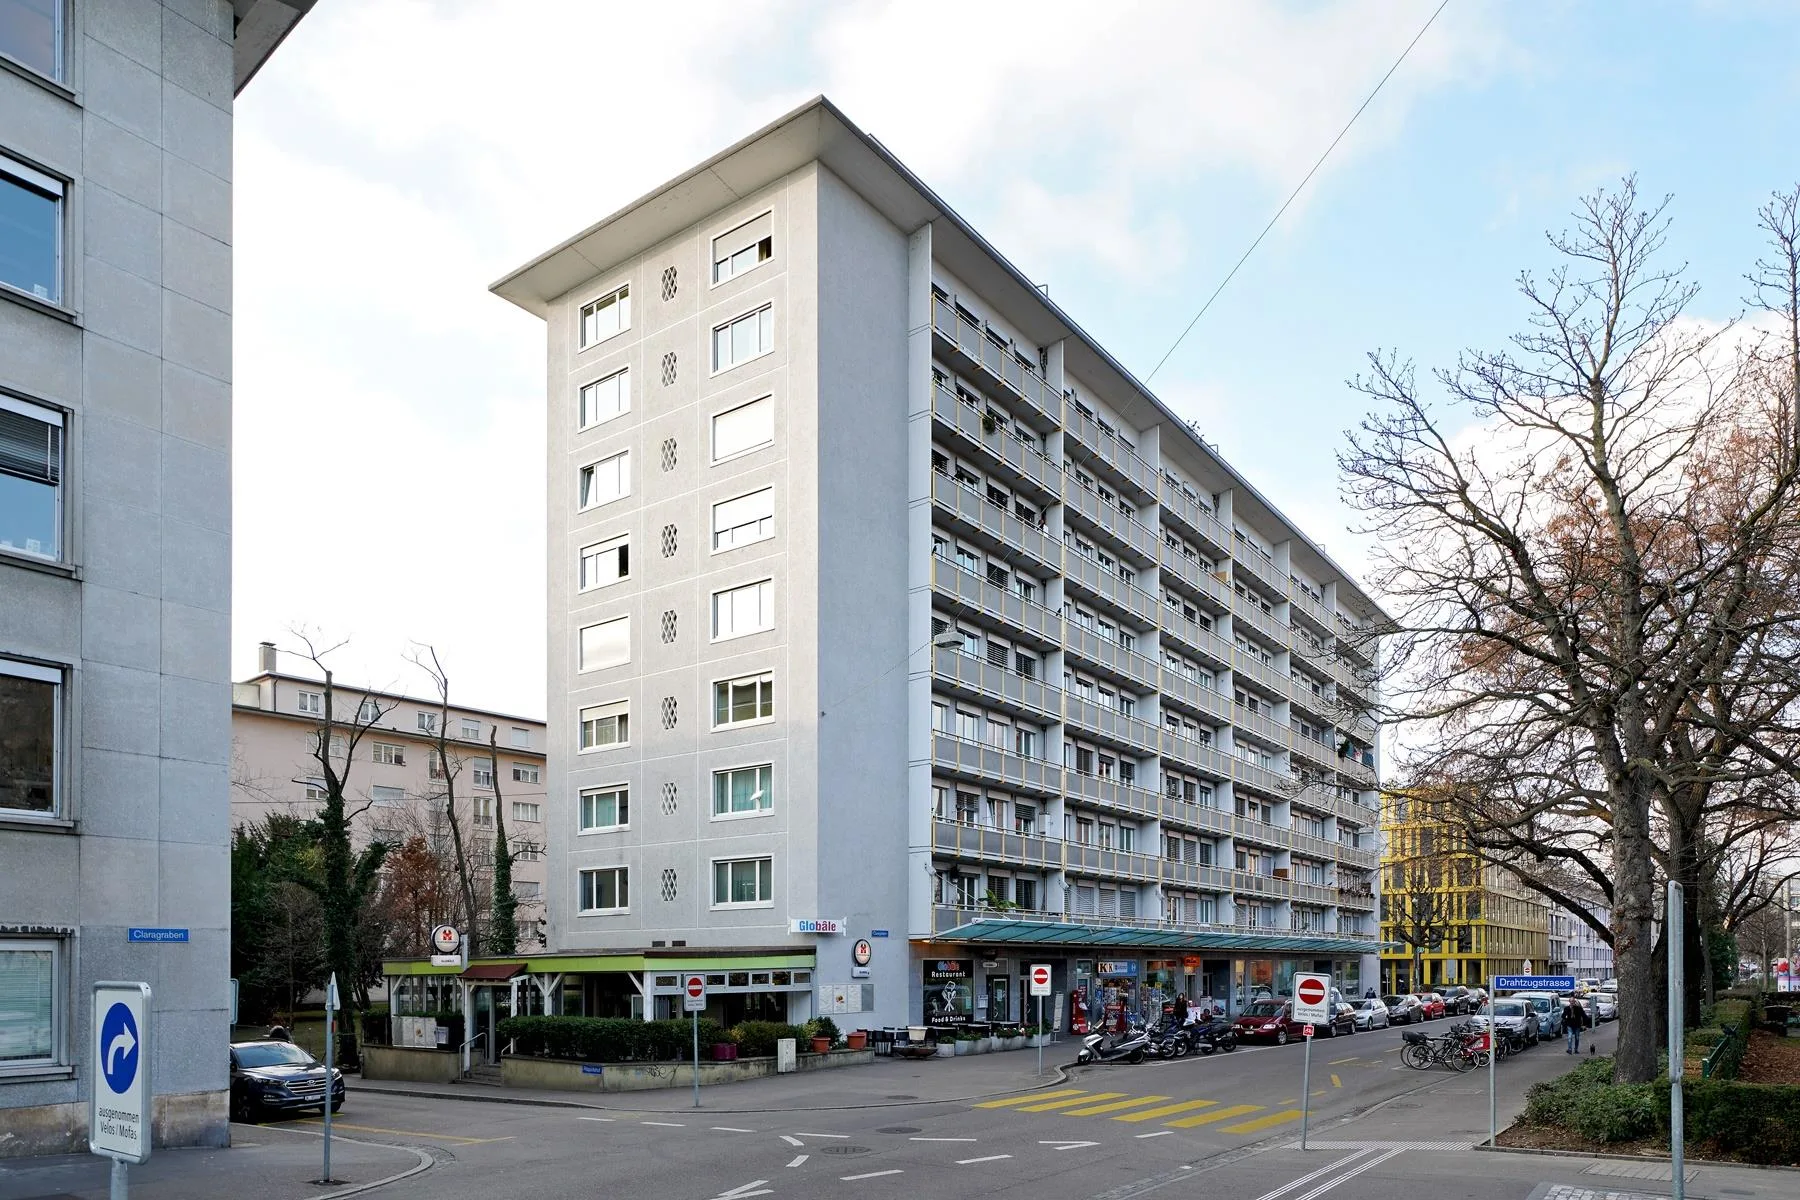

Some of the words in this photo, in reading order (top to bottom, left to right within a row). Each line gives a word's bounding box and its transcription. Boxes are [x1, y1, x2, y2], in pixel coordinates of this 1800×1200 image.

[799, 920, 836, 932] Globâle
[133, 929, 184, 941] Claragraben
[931, 970, 966, 978] Restaurant
[1499, 977, 1570, 989] Drahtzugstrasse
[98, 1107, 140, 1124] ausgenommen
[100, 1121, 115, 1136] Velos
[119, 1124, 138, 1140] Mofas
